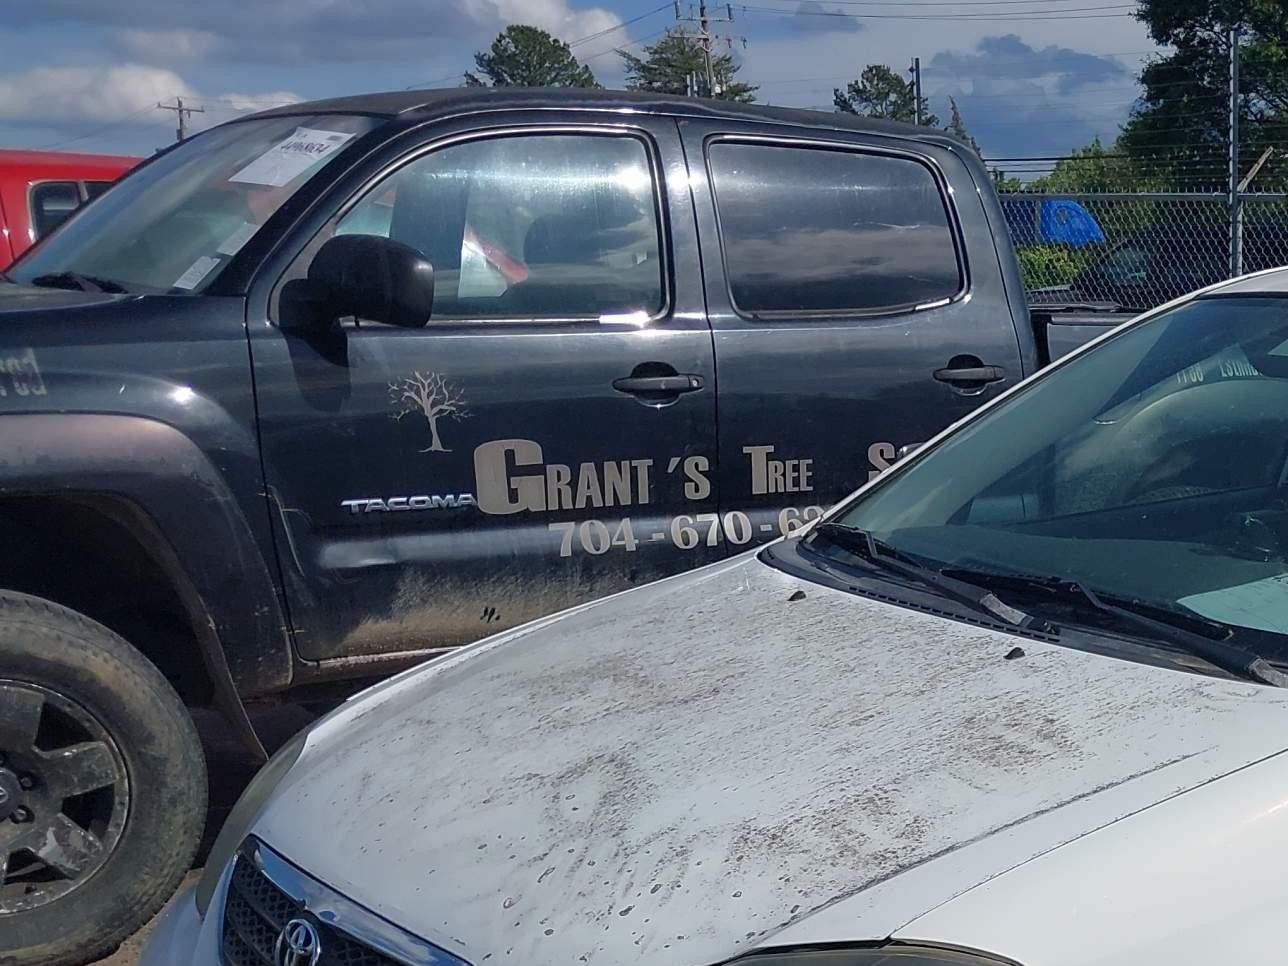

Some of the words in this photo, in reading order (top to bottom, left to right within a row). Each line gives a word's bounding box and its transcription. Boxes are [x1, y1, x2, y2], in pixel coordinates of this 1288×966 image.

[473, 438, 653, 515] GRANT
[743, 445, 813, 495] TREE
[341, 493, 478, 514] TACOMA
